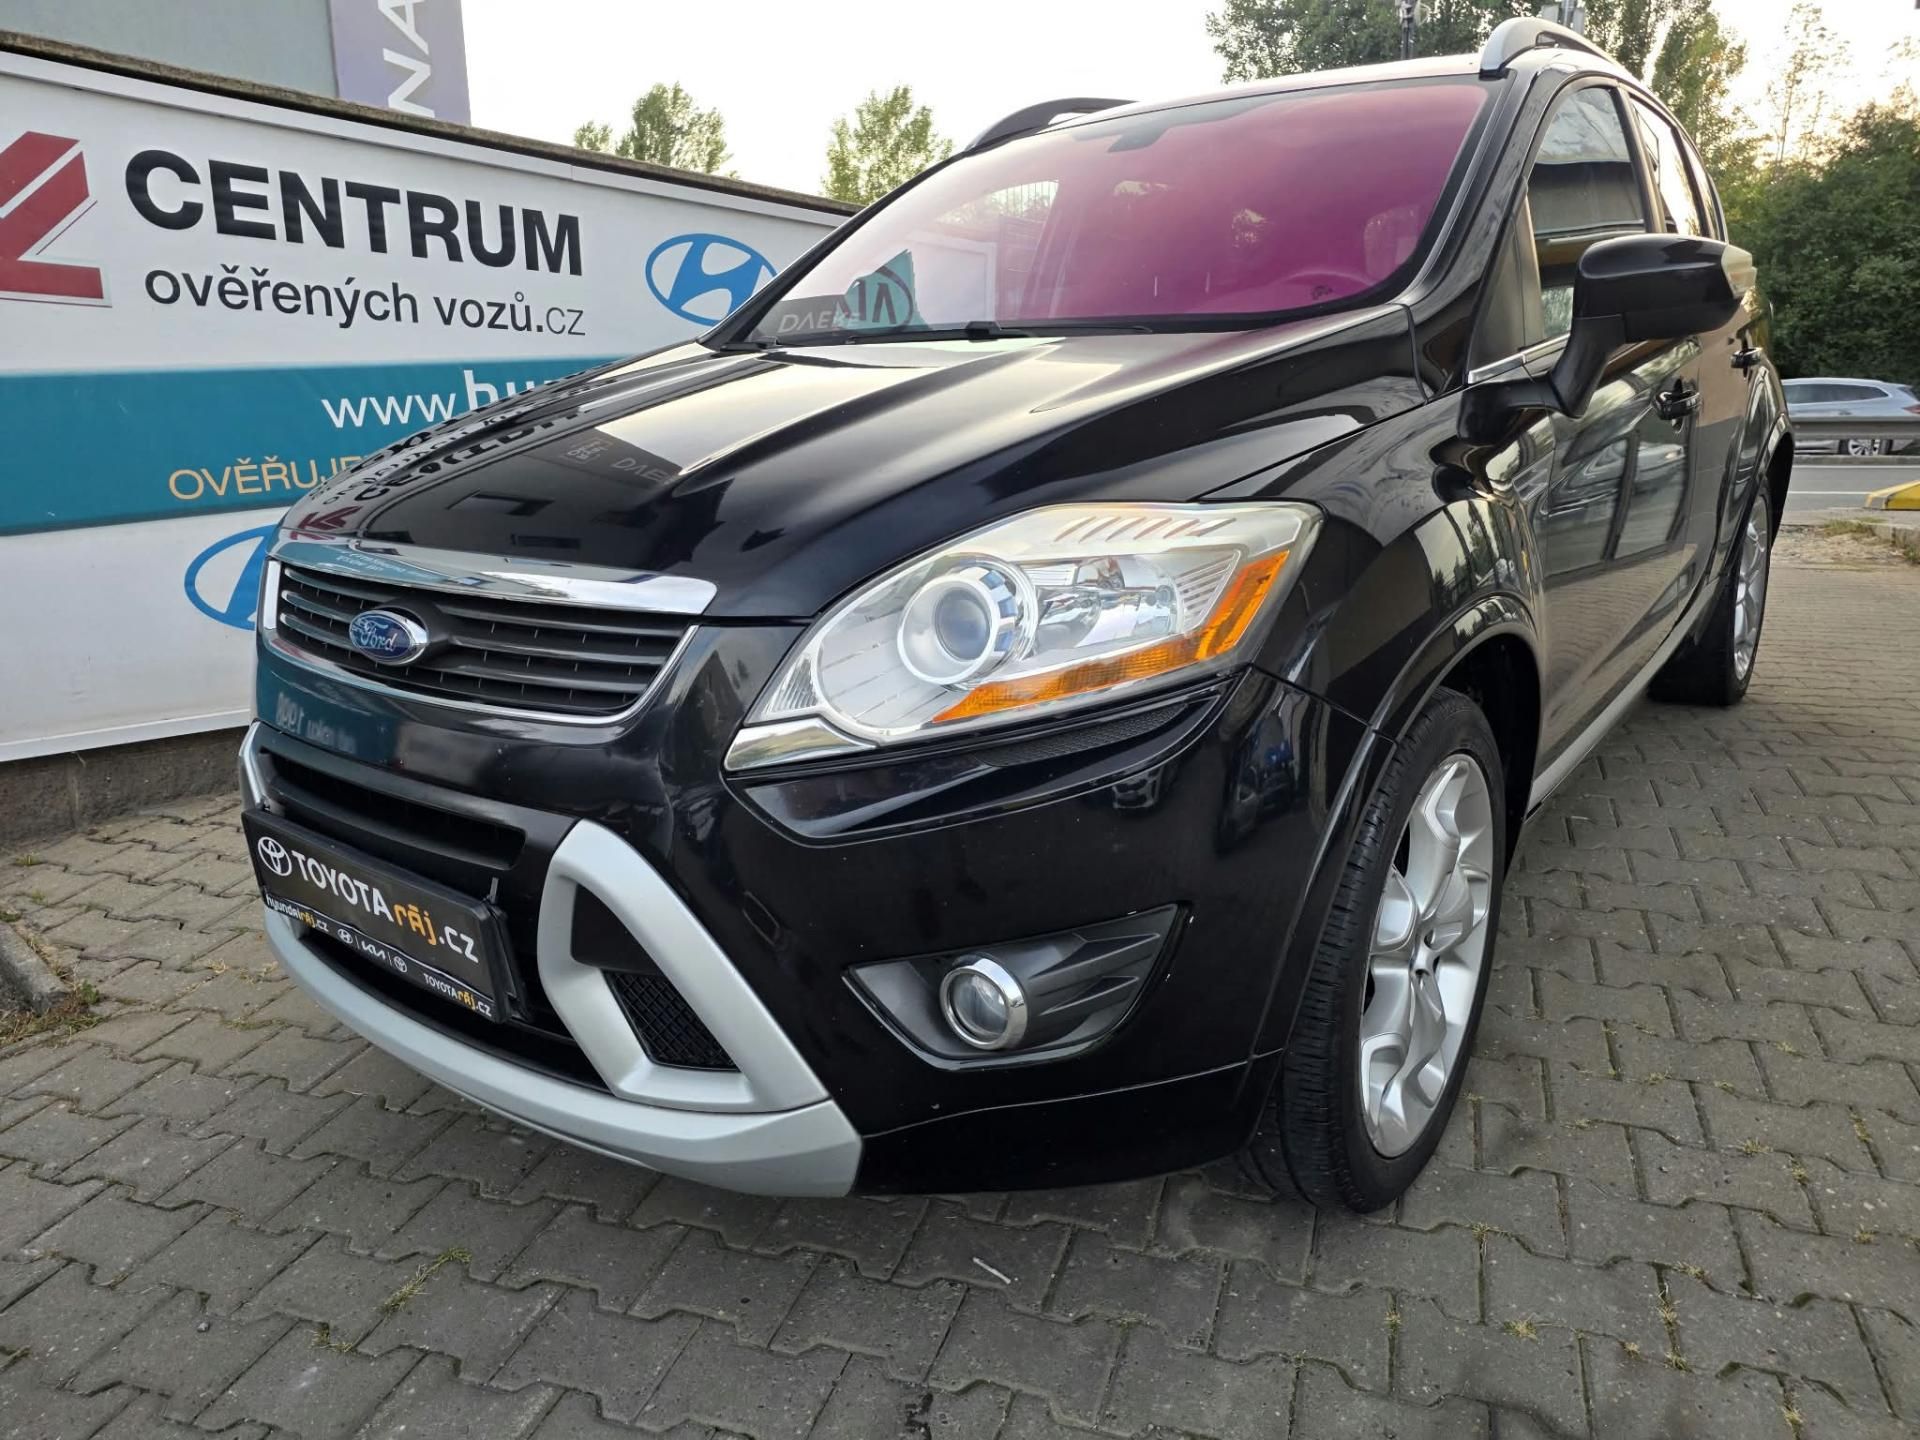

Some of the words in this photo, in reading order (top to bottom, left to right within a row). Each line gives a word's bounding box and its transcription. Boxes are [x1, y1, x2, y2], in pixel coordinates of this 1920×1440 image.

[125, 149, 583, 277] CENTRUM
[144, 263, 419, 329] ověřených
[433, 291, 587, 337] vozů.cz
[360, 619, 399, 653] Ford
